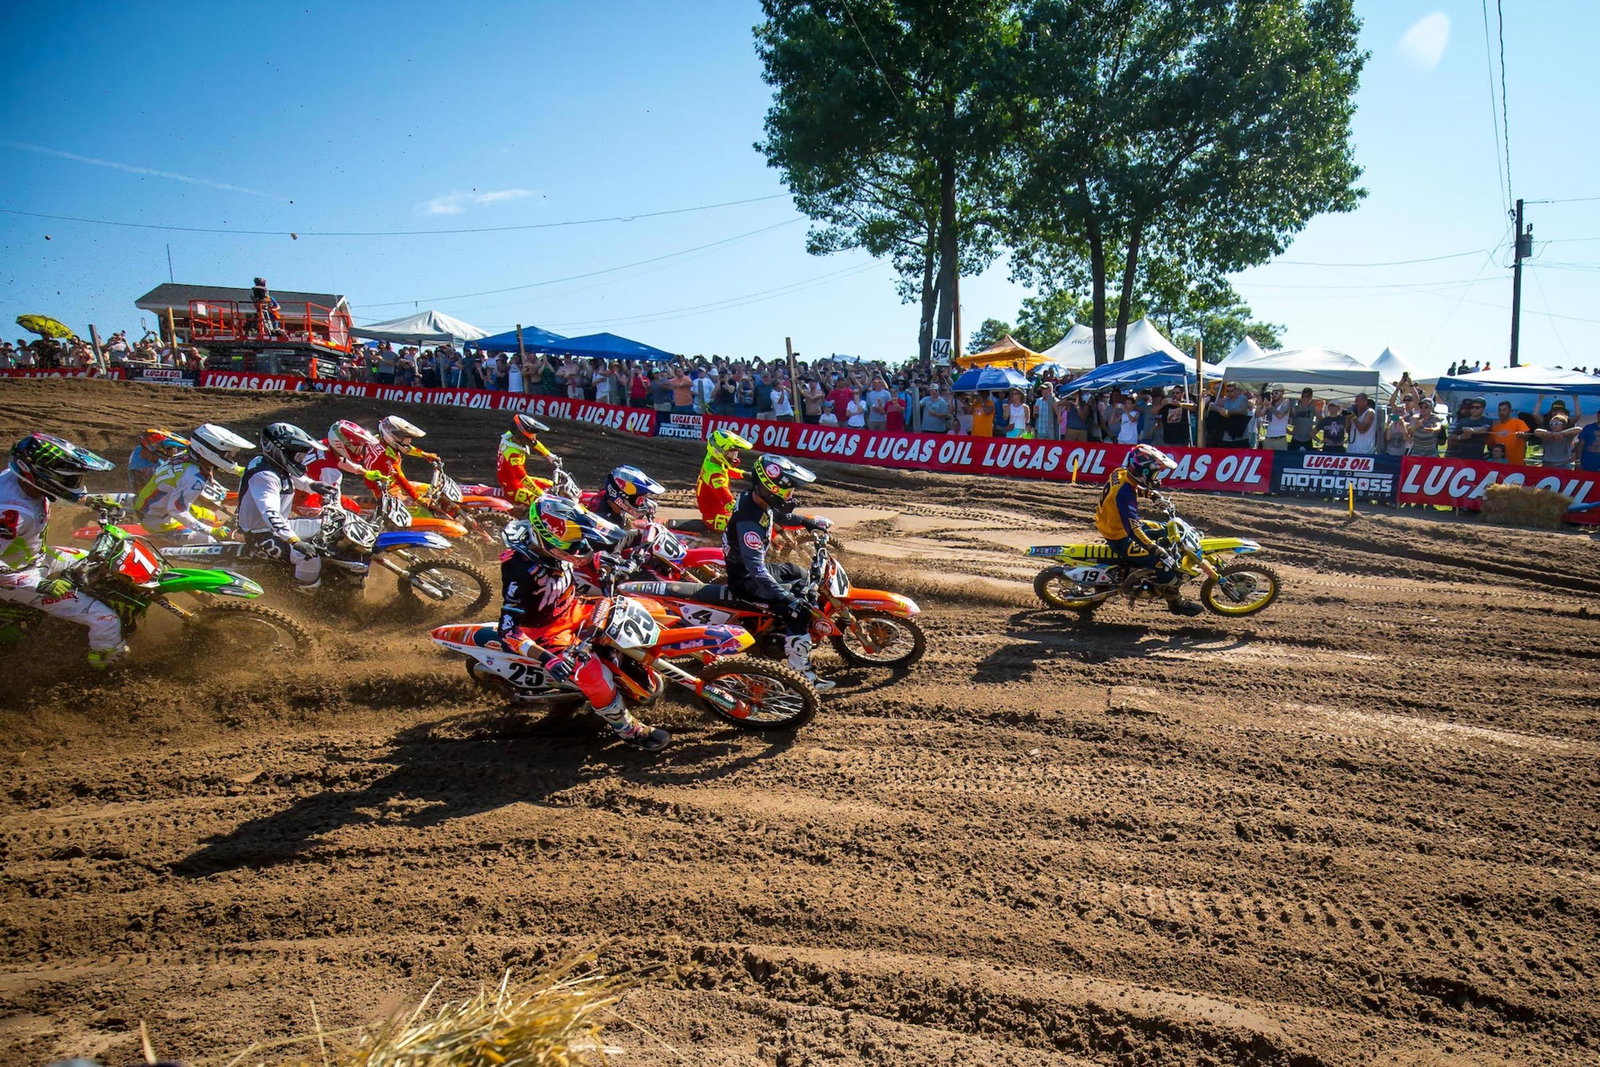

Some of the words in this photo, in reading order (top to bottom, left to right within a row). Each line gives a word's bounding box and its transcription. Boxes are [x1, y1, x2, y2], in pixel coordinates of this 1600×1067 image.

[932, 339, 950, 358] 94
[205, 375, 259, 390] LUCAS
[262, 378, 287, 391] OIL
[469, 394, 492, 410] OIL
[499, 396, 546, 416] LUCAS
[548, 401, 572, 419] OIL
[576, 404, 625, 429] LUCAS
[626, 412, 651, 433] OIL
[672, 415, 690, 423] LUCAS
[691, 416, 701, 424] OIL
[763, 425, 790, 448] OIL
[797, 429, 860, 456] LUCAS
[863, 434, 936, 463] LUCAS
[938, 440, 973, 465] OIL
[982, 443, 1063, 472] LUCAS
[1066, 447, 1106, 475] OIL
[1215, 456, 1263, 483] OIL
[1306, 456, 1348, 469] LUCAS
[1350, 458, 1371, 470] OIL
[1281, 473, 1393, 492] MOTOCROSS
[133, 547, 156, 575] 1
[1081, 569, 1100, 583] 19
[624, 606, 655, 644] 25
[691, 609, 712, 625] 4
[508, 663, 545, 687] 25
